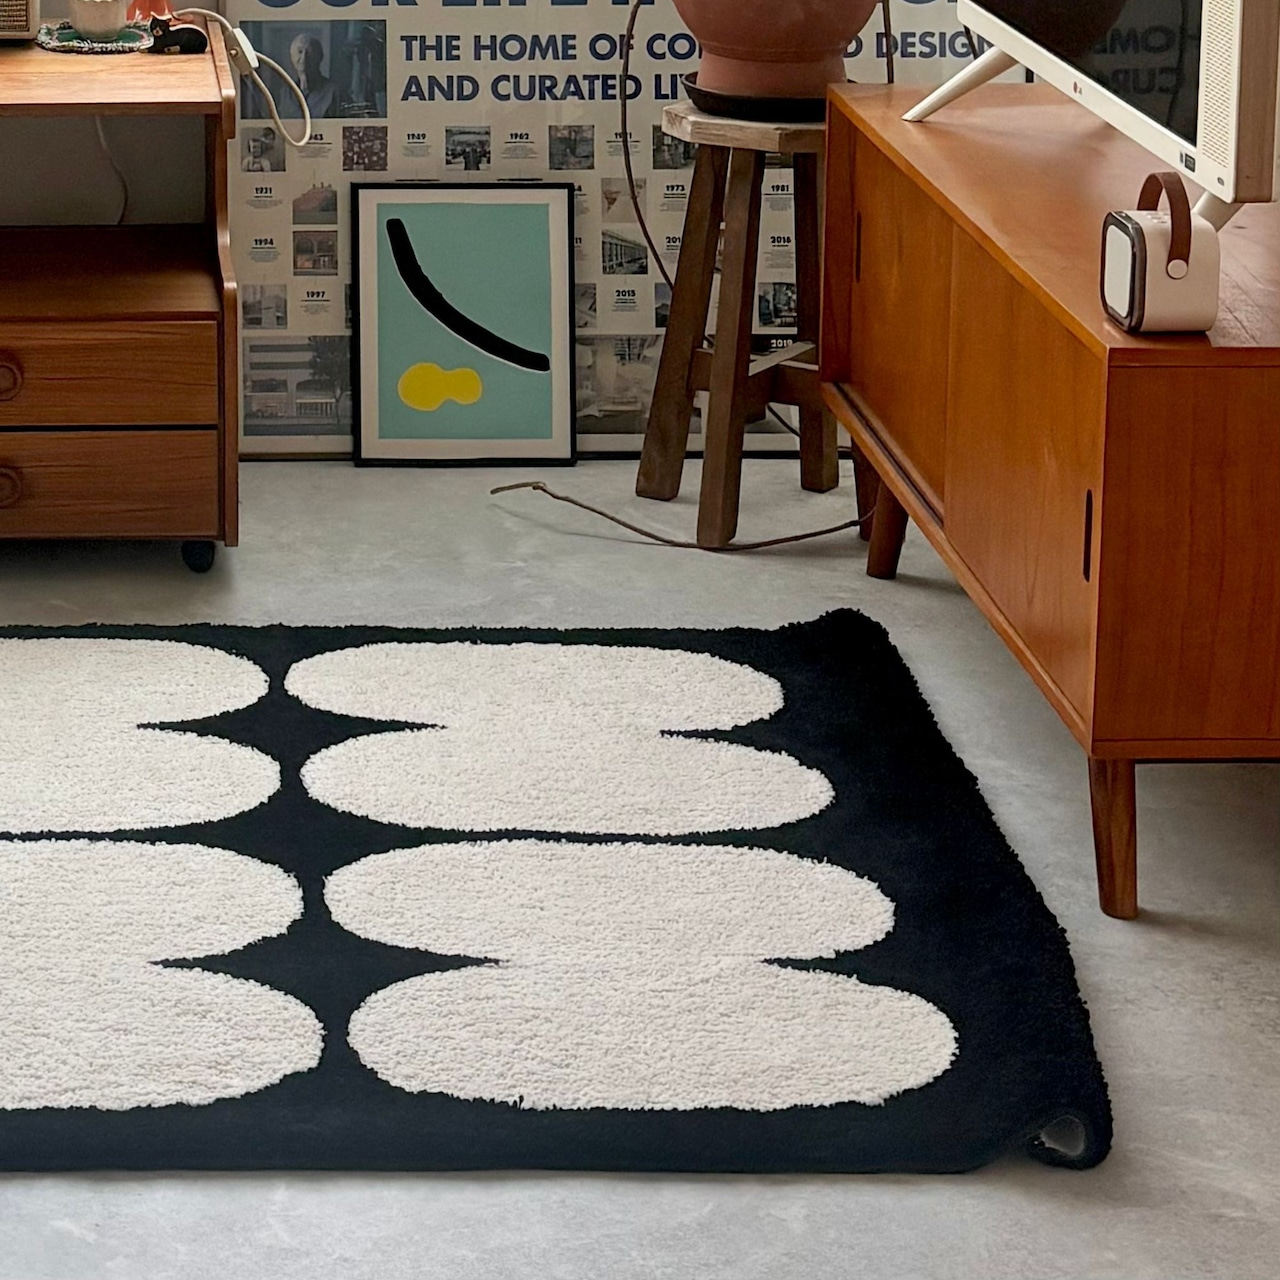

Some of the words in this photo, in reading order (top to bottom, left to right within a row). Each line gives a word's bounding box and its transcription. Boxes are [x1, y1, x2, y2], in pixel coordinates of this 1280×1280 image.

[400, 34, 461, 62] THE
[473, 33, 577, 62] HOME
[589, 33, 634, 61] OF
[646, 32, 702, 60] CO
[401, 75, 480, 102] AND
[490, 73, 642, 102] CURATED
[406, 133, 427, 141] 1949
[509, 132, 530, 140] 1962
[254, 187, 272, 195] 1931
[665, 184, 685, 192] 1973
[771, 184, 790, 192] 1981
[665, 236, 681, 244] 201
[305, 291, 325, 299] 1997
